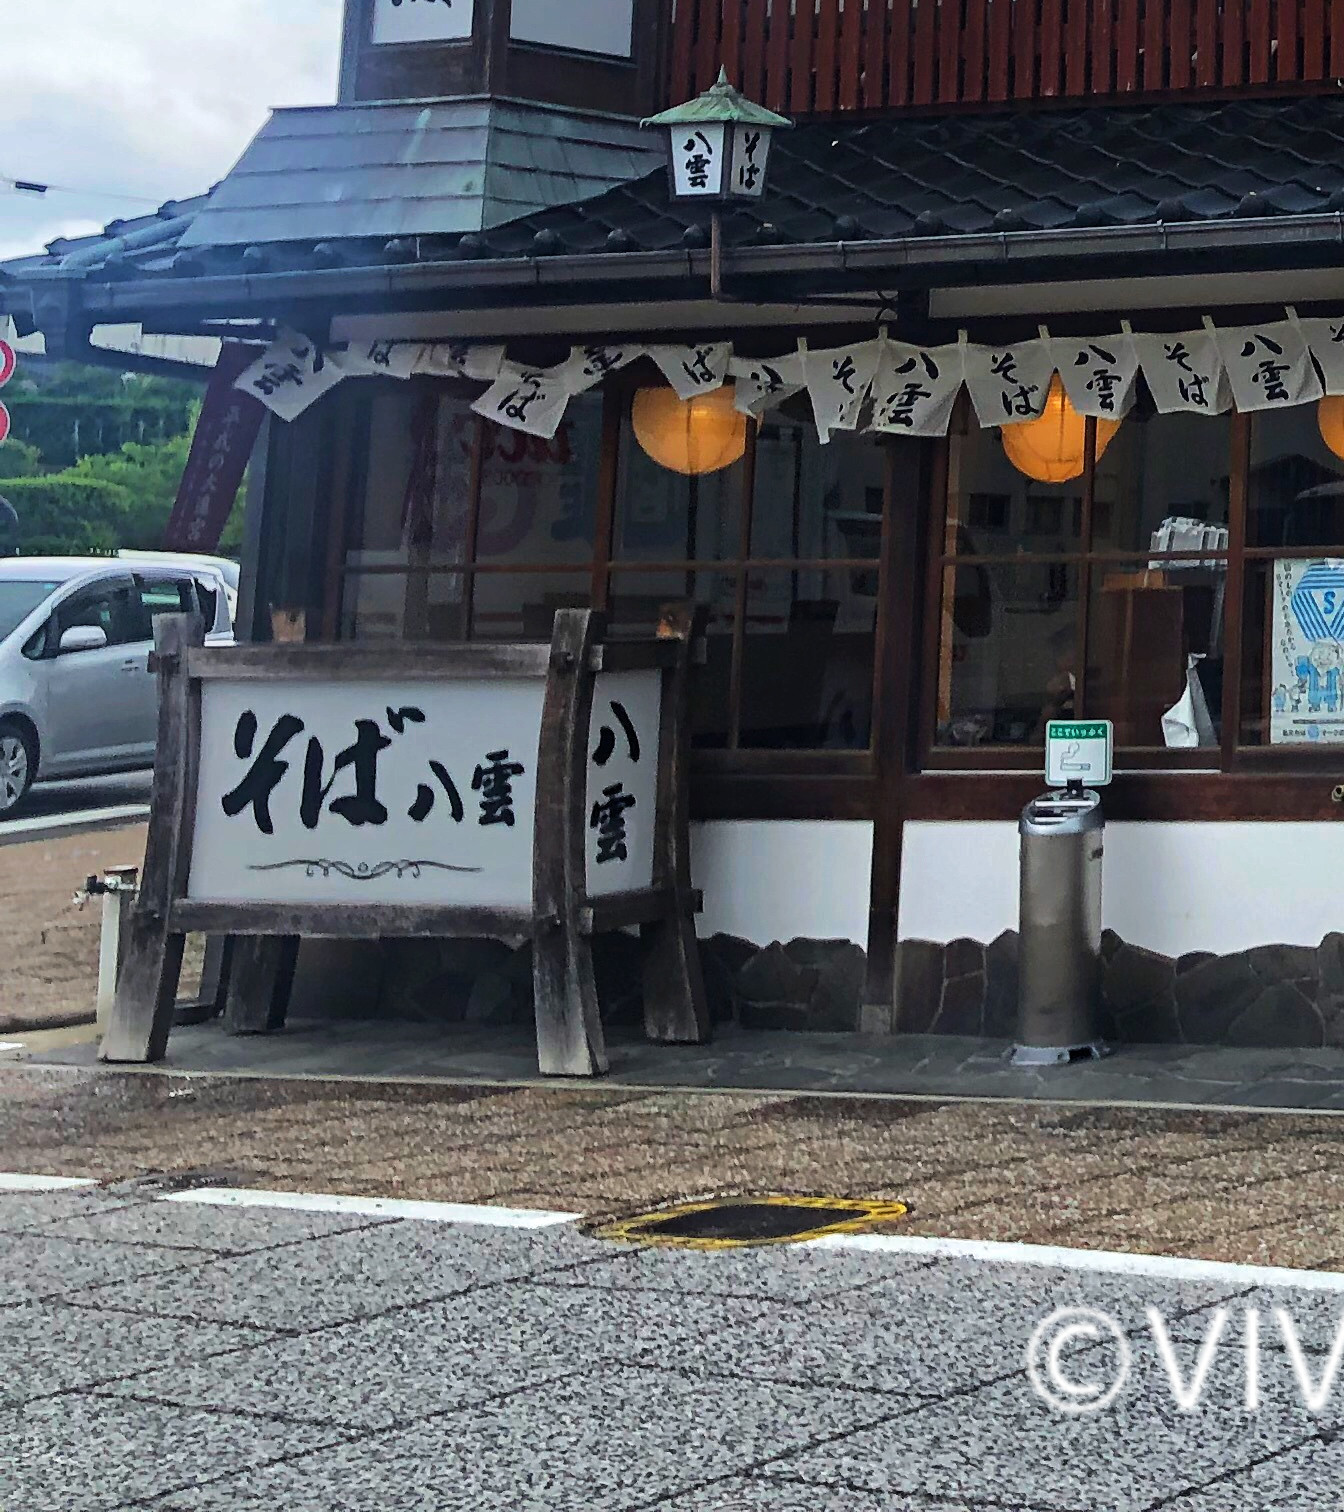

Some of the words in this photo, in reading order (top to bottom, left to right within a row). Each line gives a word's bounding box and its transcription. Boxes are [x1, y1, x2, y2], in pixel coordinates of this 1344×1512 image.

[682, 131, 713, 189] 八雲
[880, 350, 940, 428] 八雲
[990, 351, 1040, 417] そば
[1074, 344, 1122, 411] 八雲
[1163, 342, 1209, 408] そば
[1240, 333, 1291, 402] 八雲
[221, 706, 427, 836] そば
[407, 750, 526, 827] 八雲
[589, 700, 637, 863] 八雲
